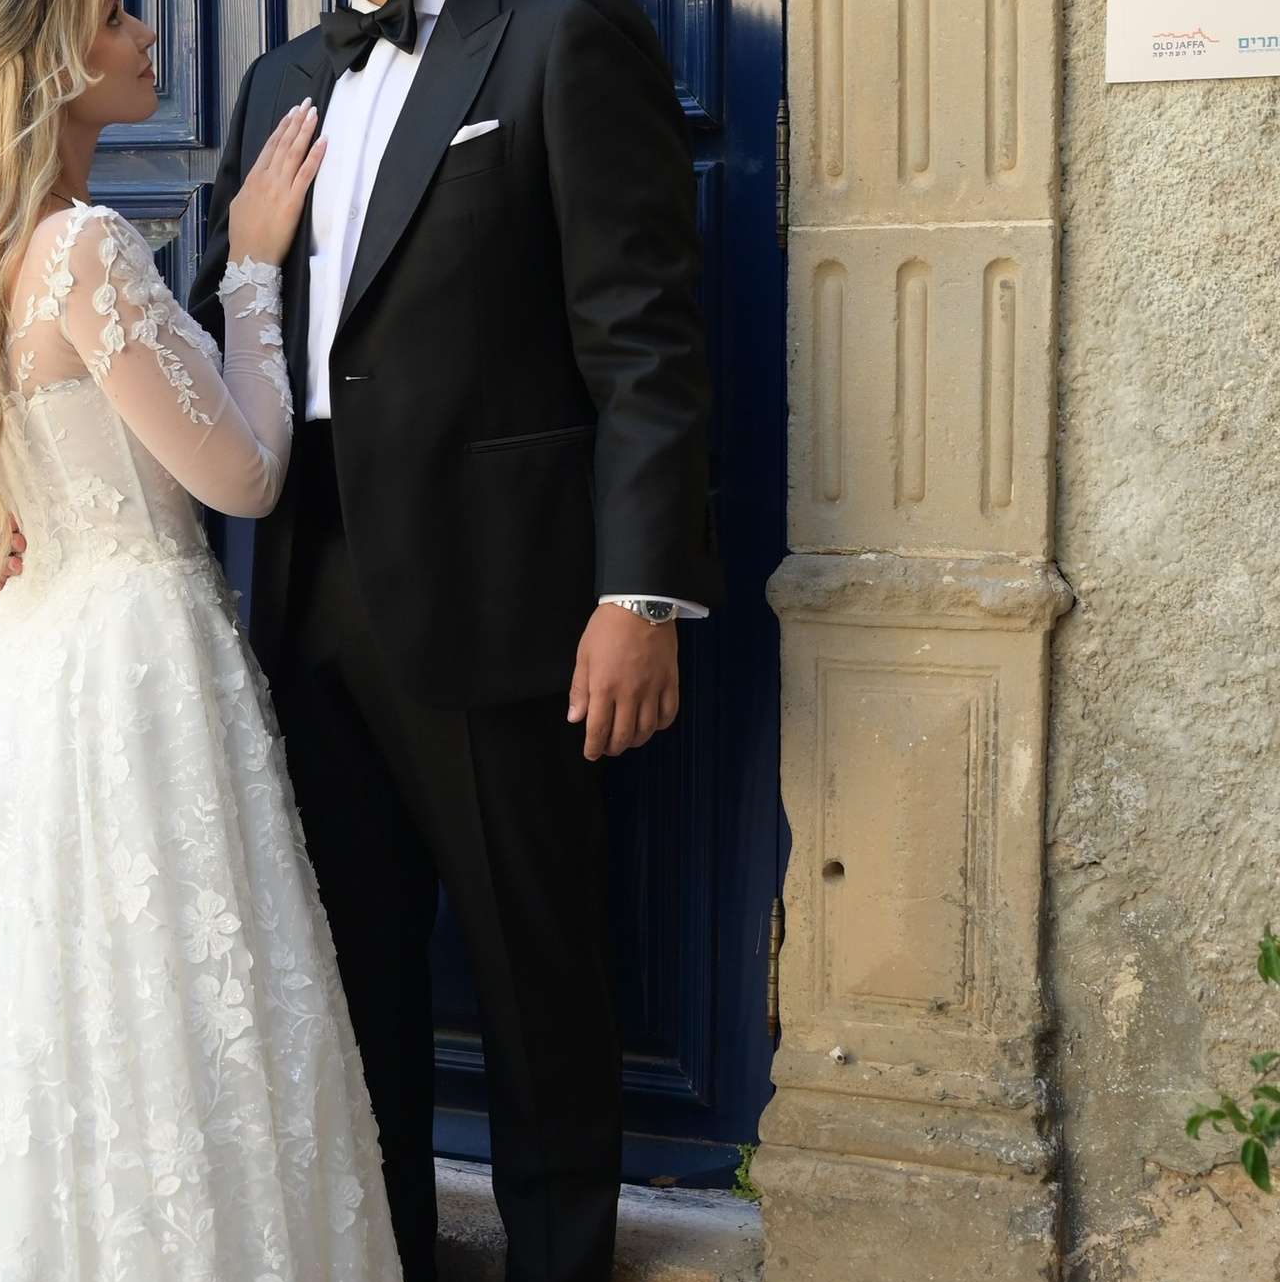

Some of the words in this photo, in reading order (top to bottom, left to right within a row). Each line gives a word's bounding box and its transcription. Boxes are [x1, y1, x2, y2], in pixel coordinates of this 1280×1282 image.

[1152, 42, 1173, 50] OLD
[1175, 40, 1205, 50] JAFFA
[1238, 36, 1280, 49] תרים
